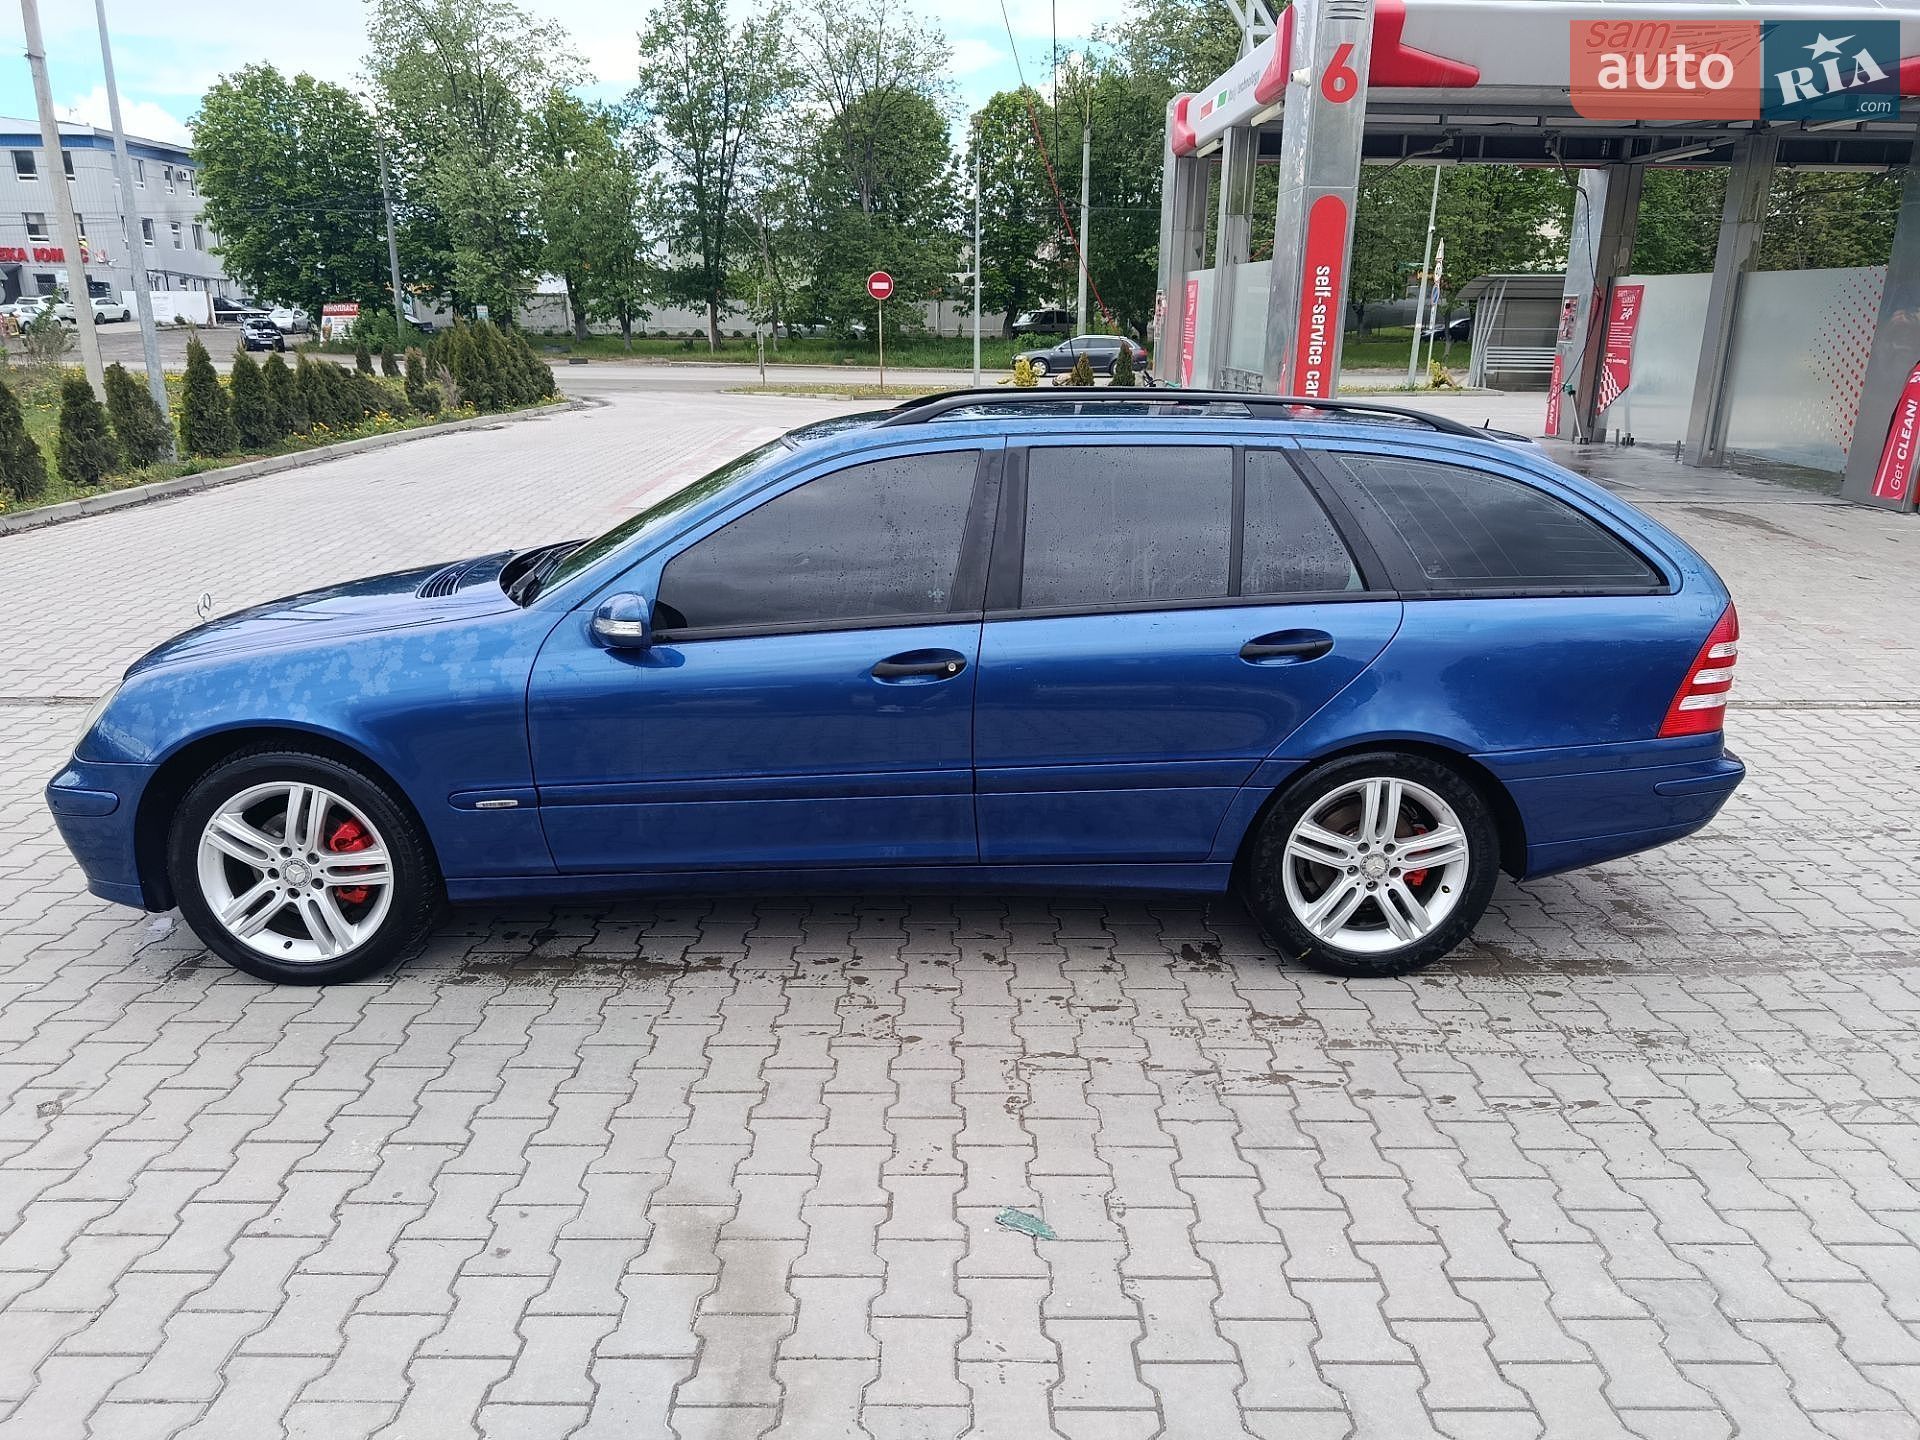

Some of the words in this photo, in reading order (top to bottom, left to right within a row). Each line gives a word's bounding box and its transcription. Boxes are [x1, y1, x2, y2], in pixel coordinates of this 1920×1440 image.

[1321, 43, 1358, 104] 6
[1308, 265, 1332, 365] self-service
[1305, 370, 1321, 397] car
[1897, 398, 1919, 461] CLEAN!
[1890, 462, 1905, 491] Get
